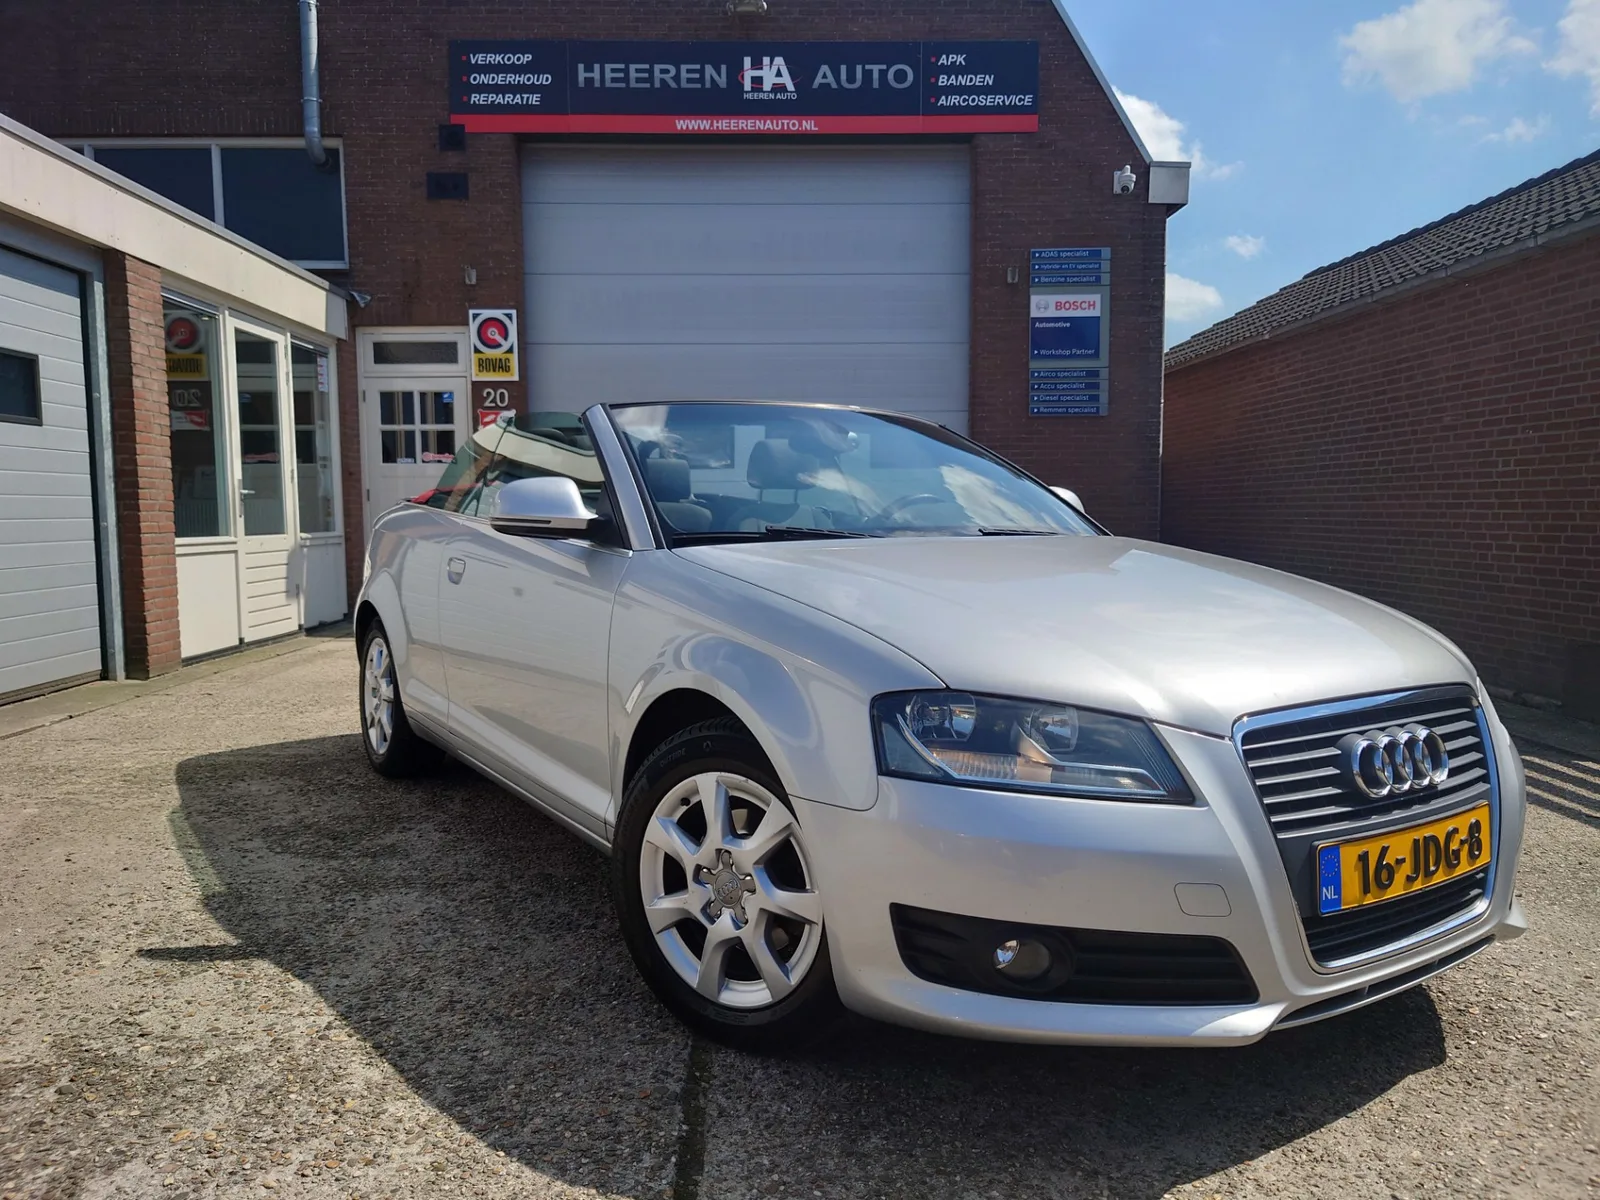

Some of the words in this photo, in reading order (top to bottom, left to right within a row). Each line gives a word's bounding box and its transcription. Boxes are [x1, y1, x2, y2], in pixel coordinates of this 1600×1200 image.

[470, 53, 532, 65] VERKOOP
[938, 54, 966, 66] APK
[470, 73, 552, 85] ONDERHOUD
[577, 63, 727, 89] HEEREN
[812, 64, 914, 89] AUTO
[743, 56, 795, 92] HA
[938, 75, 994, 86] BANDEN
[470, 94, 541, 105] REPARATIE
[938, 95, 1033, 106] AIRCOSERVICE
[676, 119, 818, 132] WWW.HEERENAUTO.NL
[1060, 250, 1089, 258] specialist
[1055, 301, 1096, 311] BOSCH
[478, 358, 511, 373] BOVAG
[1057, 370, 1086, 378] specialist
[1056, 382, 1085, 390] specialist
[483, 388, 509, 407] 20
[1060, 394, 1089, 402] specialist
[1067, 406, 1096, 414] specialist
[1358, 818, 1482, 895] 16-JDG-8
[1322, 885, 1338, 901] NL
